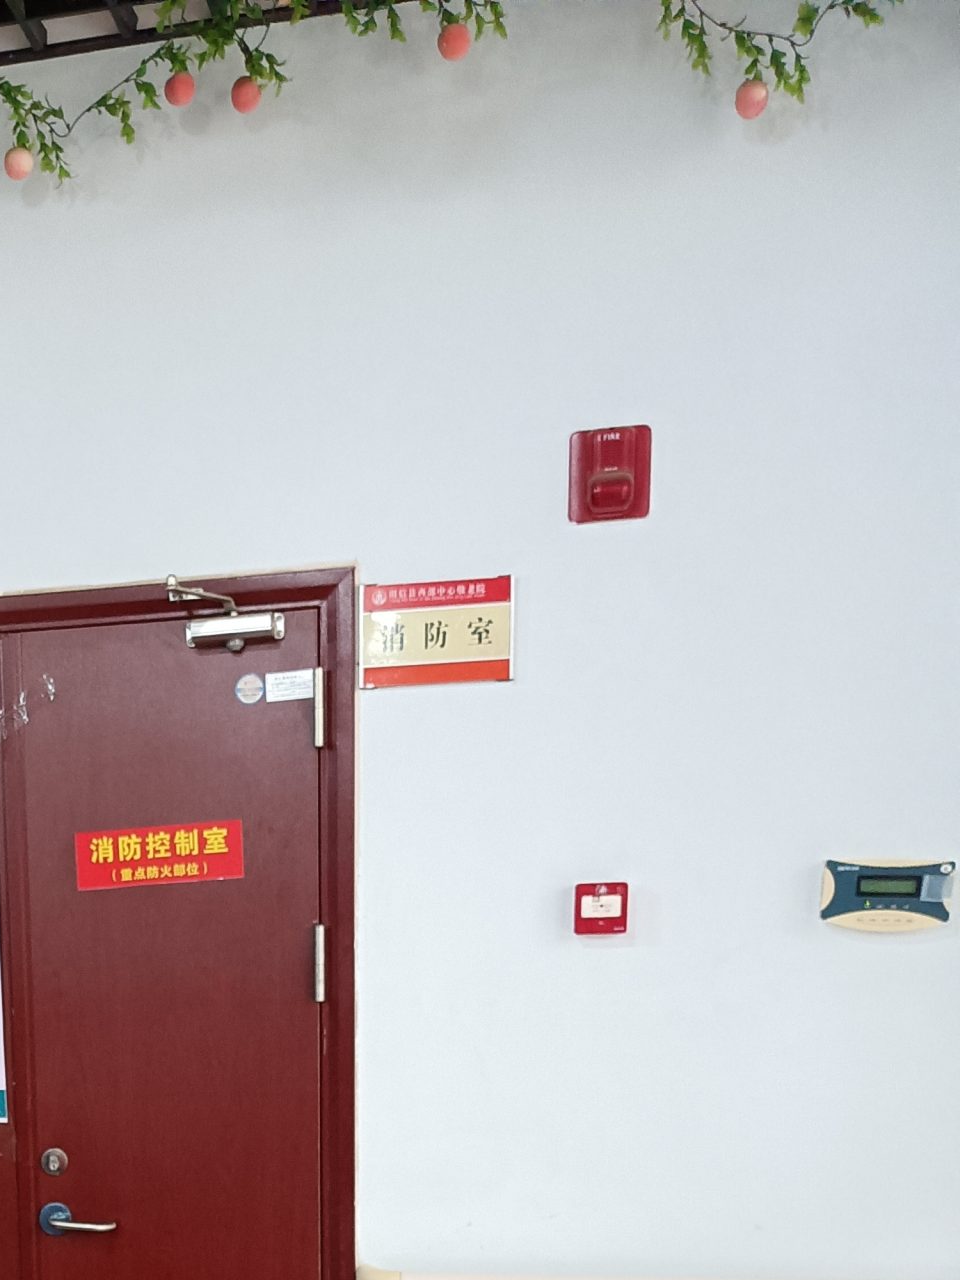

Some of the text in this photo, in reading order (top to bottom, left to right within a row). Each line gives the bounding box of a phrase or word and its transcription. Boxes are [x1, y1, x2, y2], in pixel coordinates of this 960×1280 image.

[382, 617, 493, 651] 消防室
[90, 827, 229, 864] 消防控制室
[111, 861, 208, 882] （重点防火部位）
